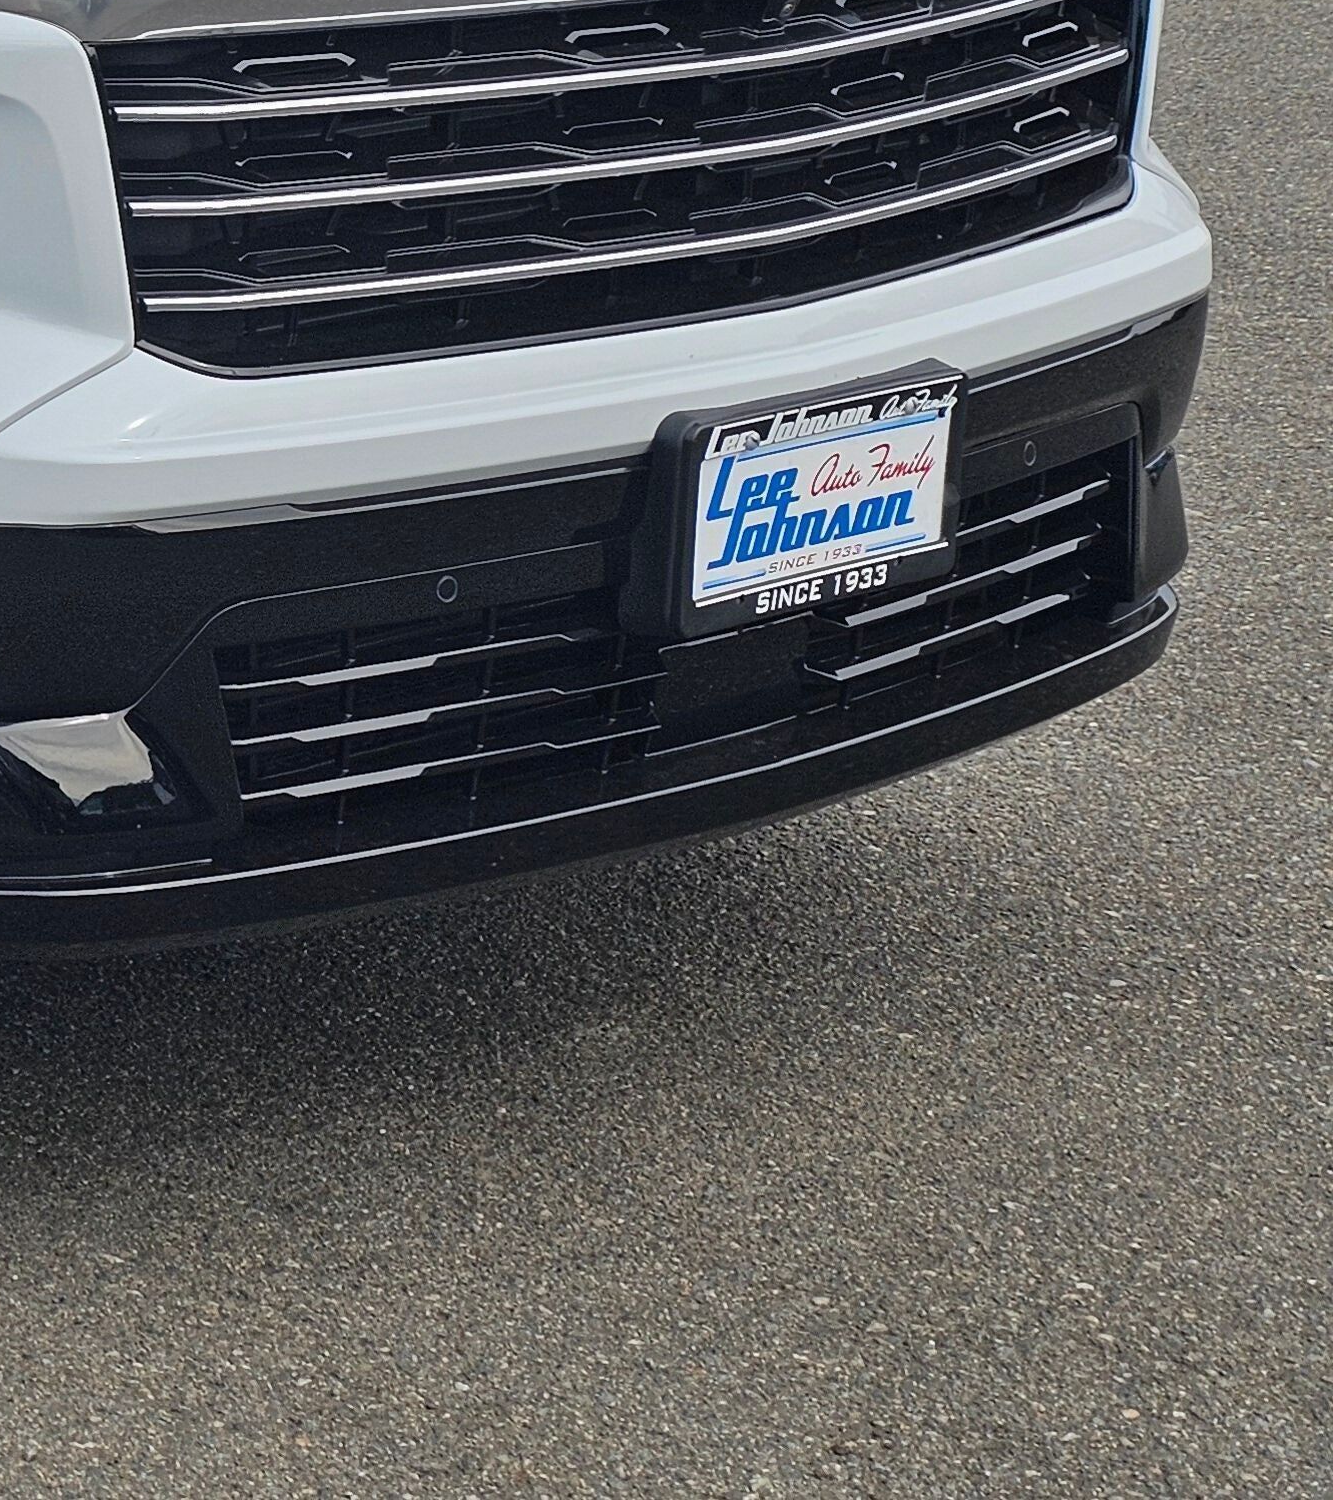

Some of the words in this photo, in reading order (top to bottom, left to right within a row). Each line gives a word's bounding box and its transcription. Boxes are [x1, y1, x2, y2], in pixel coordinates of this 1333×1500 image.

[761, 406, 874, 447] Johnson
[706, 456, 800, 522] Lee
[810, 452, 863, 497] Auto
[867, 434, 936, 490] Family
[706, 489, 915, 571] Johnson
[768, 553, 816, 574] SINCE
[823, 543, 864, 561] 1933
[755, 578, 822, 614] SINCE
[833, 564, 889, 596] 1933
